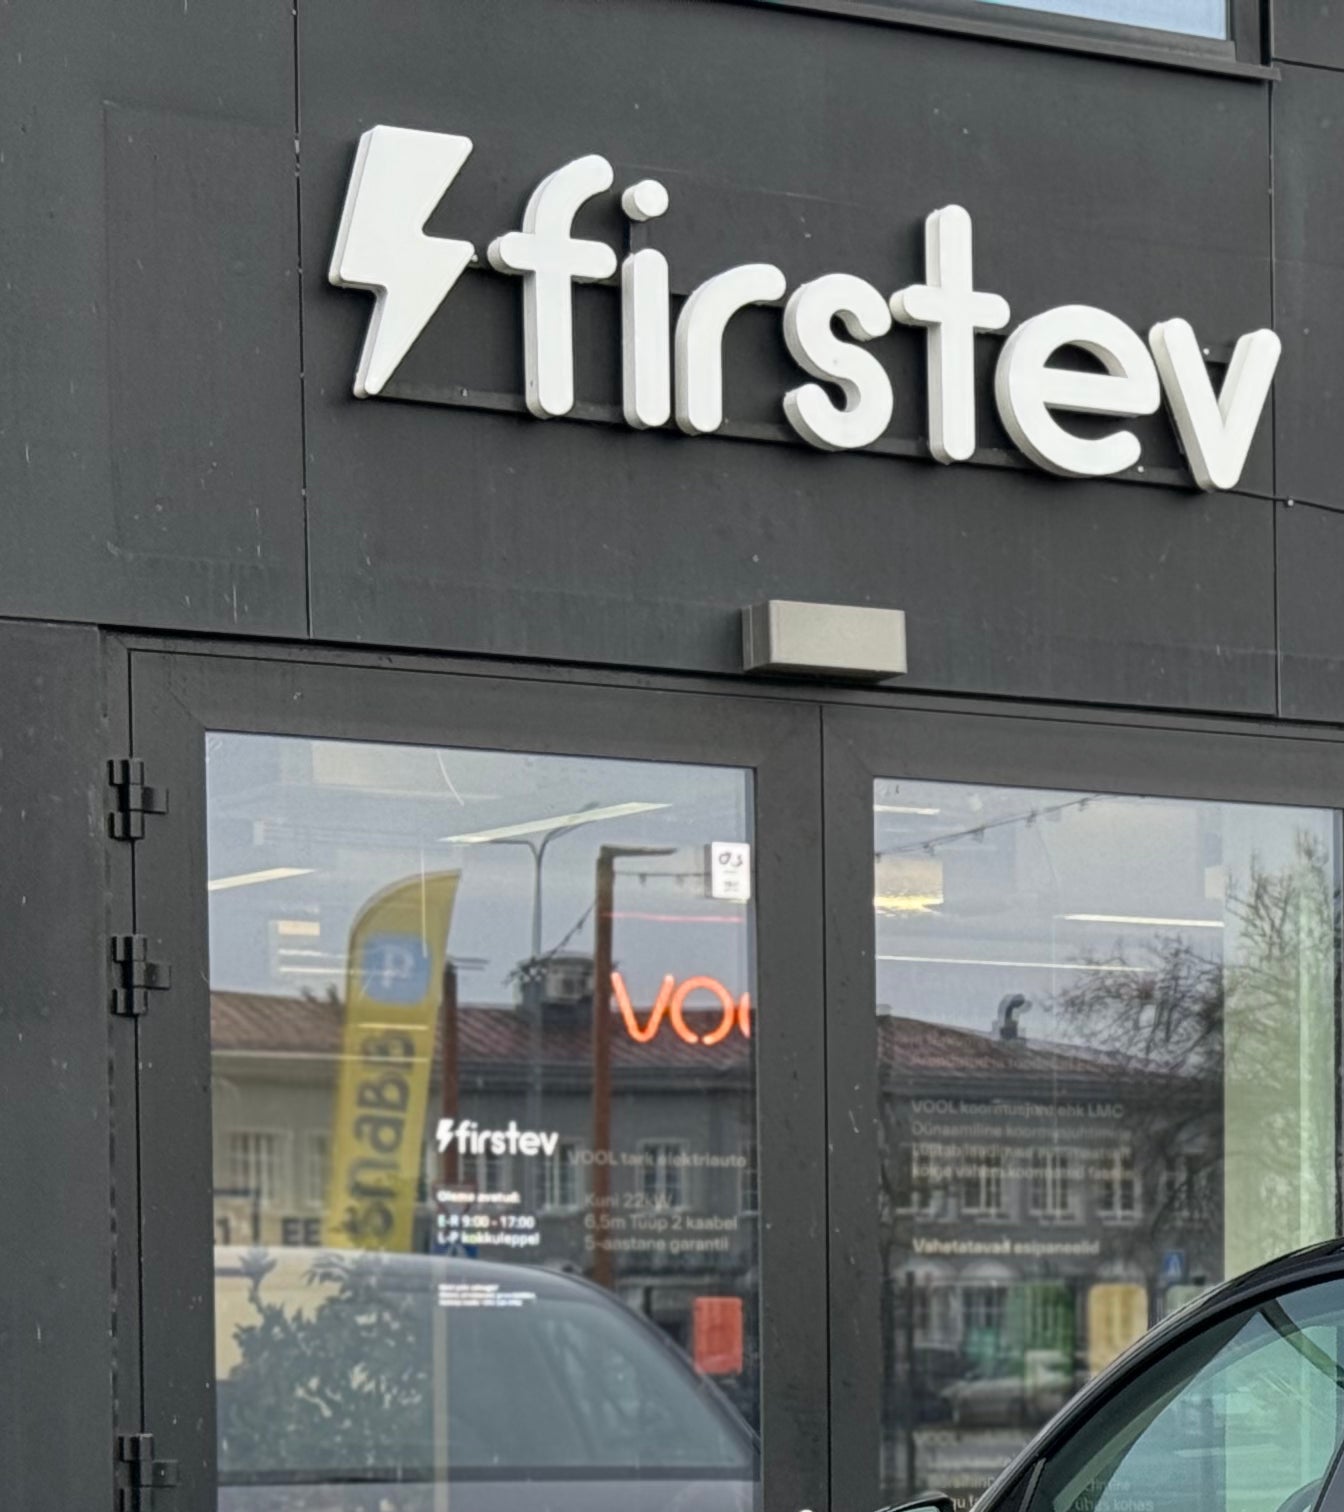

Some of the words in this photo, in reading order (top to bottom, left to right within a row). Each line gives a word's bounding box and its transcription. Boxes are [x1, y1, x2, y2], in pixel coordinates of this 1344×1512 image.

[486, 153, 1283, 493] firstev
[455, 1118, 559, 1156] firstev
[567, 1151, 619, 1166] VOOL
[461, 1215, 490, 1228] 9:00
[500, 1215, 535, 1229] 17:00
[671, 1215, 682, 1230] 2
[686, 1215, 738, 1231] kaabel
